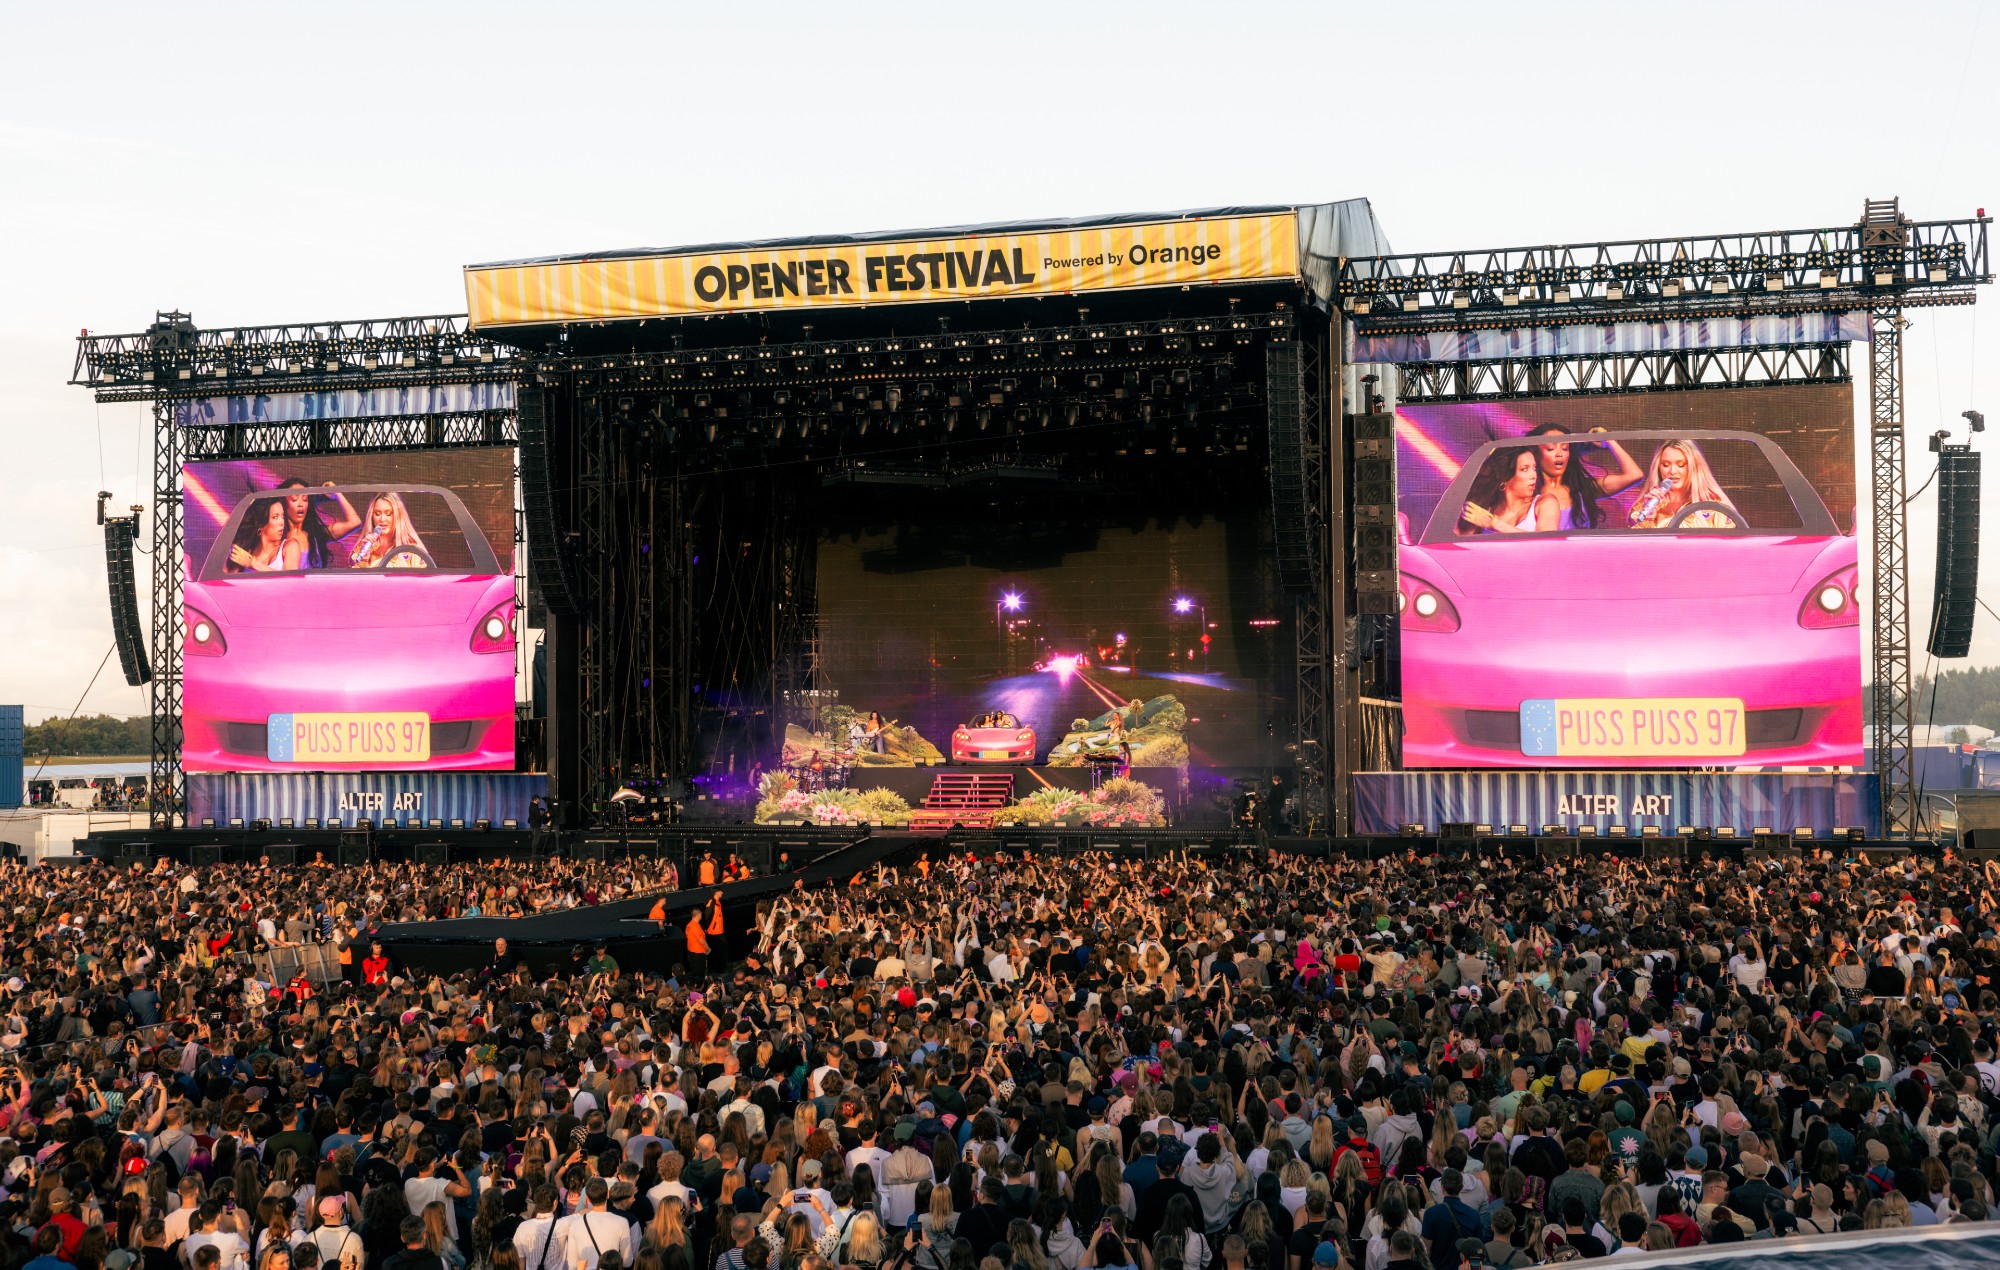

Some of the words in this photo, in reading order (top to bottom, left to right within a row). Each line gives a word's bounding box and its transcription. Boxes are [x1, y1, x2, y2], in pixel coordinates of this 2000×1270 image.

[1044, 253, 1104, 270] Powered
[1108, 252, 1124, 266] by
[1129, 244, 1221, 266] Orange
[694, 259, 854, 302] OPEN'ER
[865, 248, 1036, 293] FESTIVAL
[296, 722, 342, 753] PUSS
[349, 722, 396, 753] PUSS
[403, 721, 425, 753] 97
[1559, 710, 1624, 746] PUSS
[1633, 709, 1698, 746] PUSS
[1707, 709, 1738, 746] 97
[279, 745, 284, 758] S
[1537, 737, 1543, 751] S
[338, 792, 384, 811] ALTER
[393, 792, 423, 811] ART
[1557, 794, 1619, 815] ALTER
[1631, 794, 1673, 815] ART
